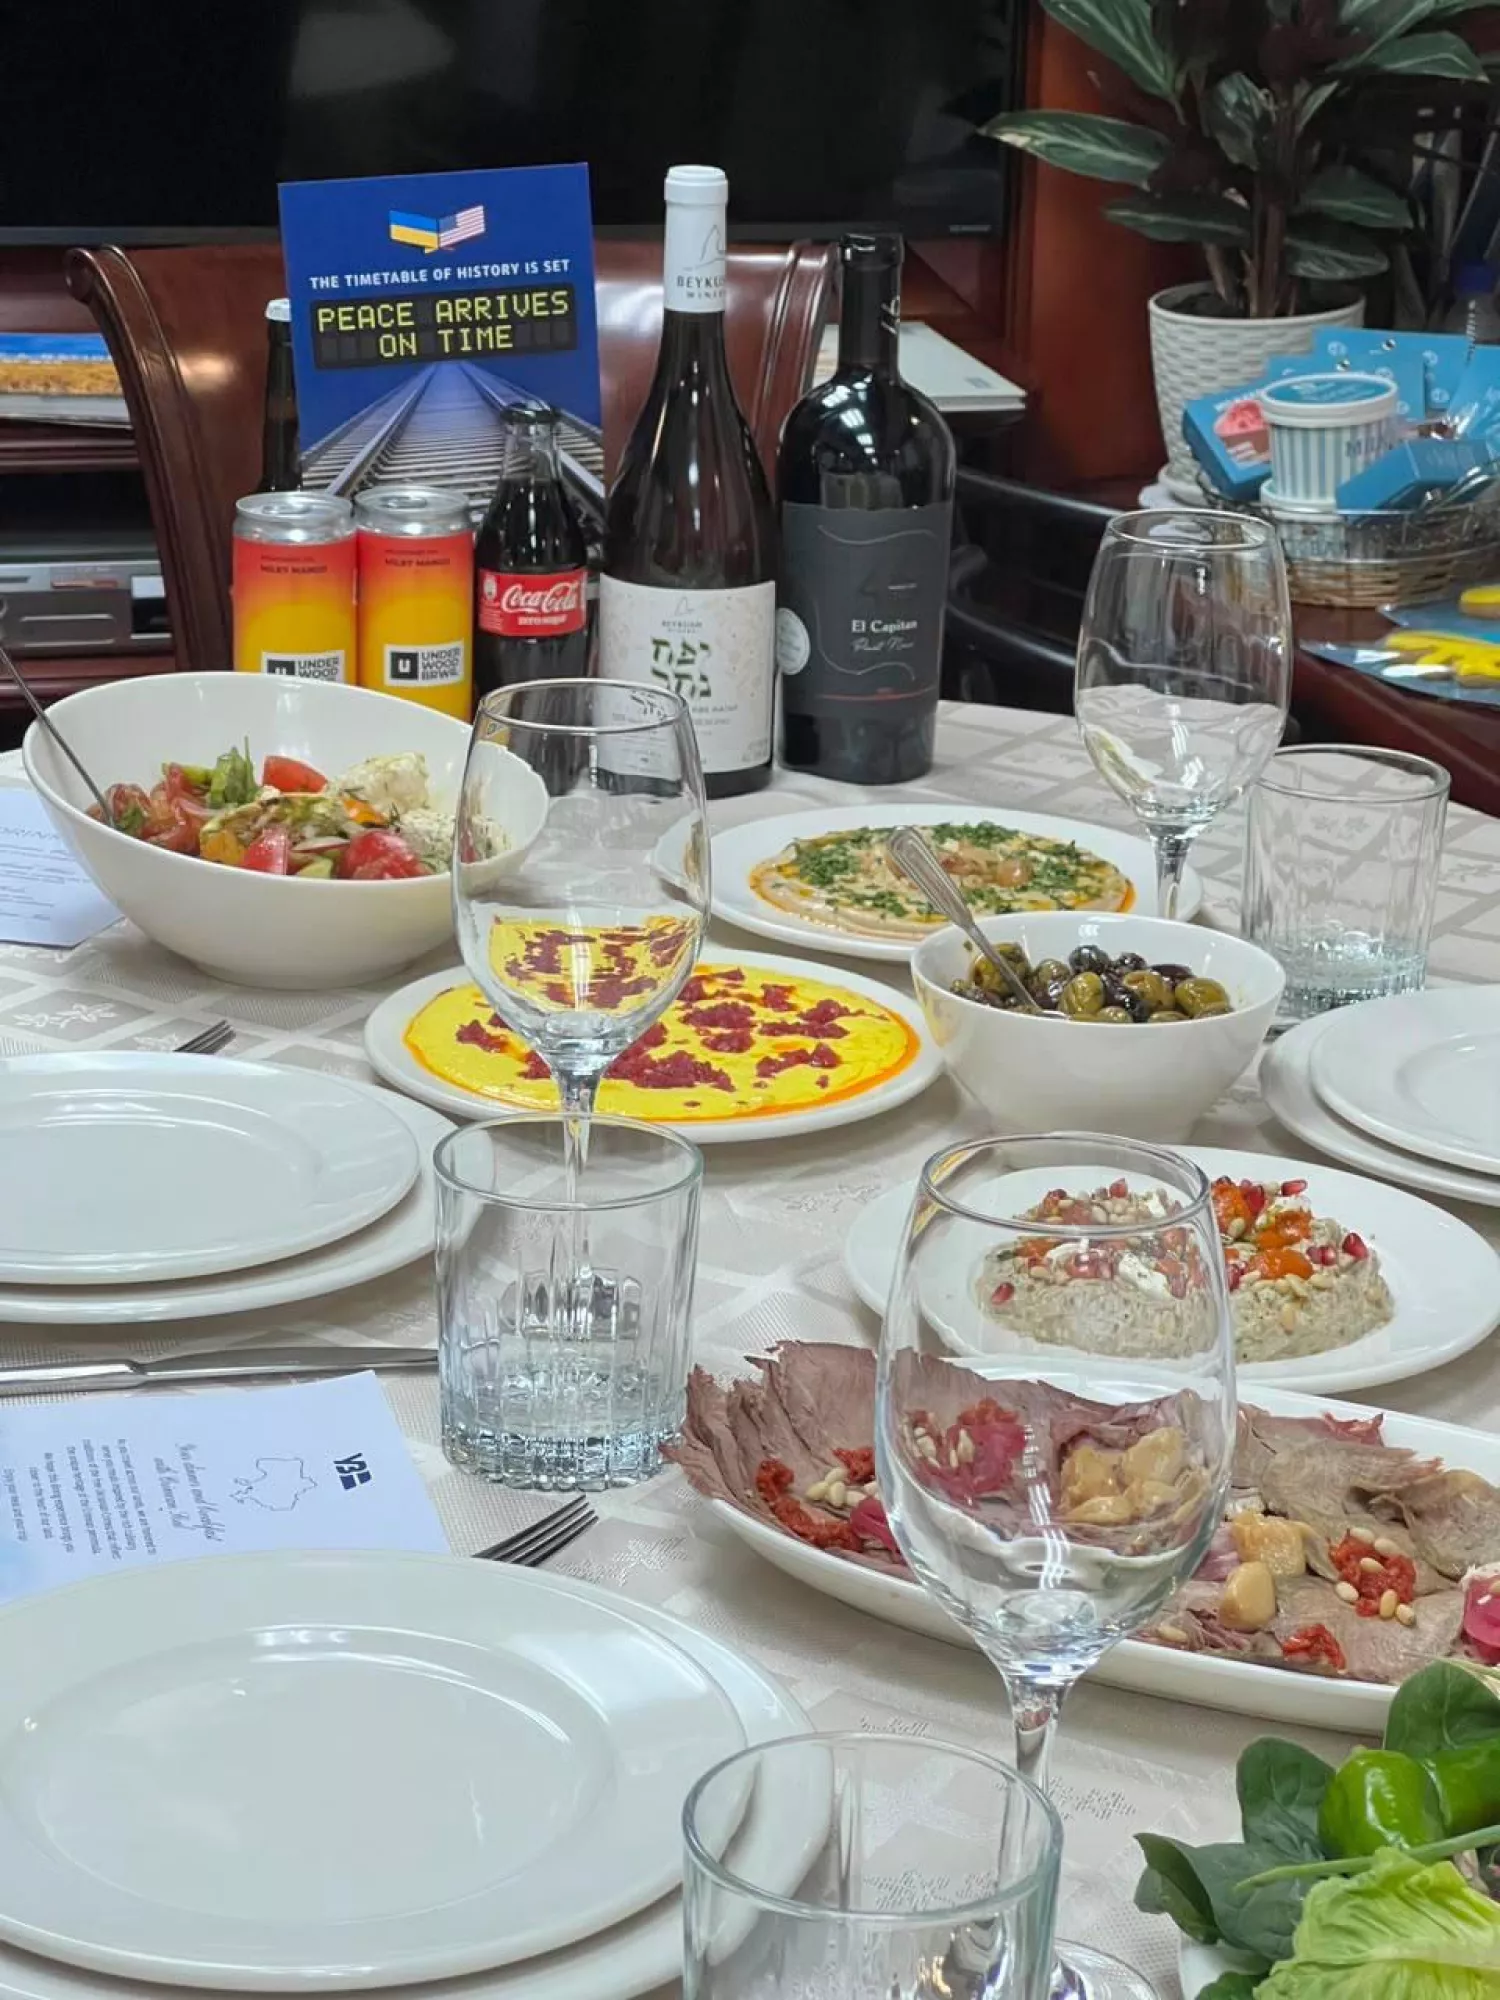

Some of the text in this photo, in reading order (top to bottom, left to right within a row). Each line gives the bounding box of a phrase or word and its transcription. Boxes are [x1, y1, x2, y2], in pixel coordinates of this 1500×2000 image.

[310, 259, 570, 289] THE TIMETABLE OF HISTORY IS SET
[317, 290, 569, 333] PEACE ARRIVES
[379, 324, 514, 358] ON TIME
[851, 618, 918, 633] El Capitan
[299, 655, 340, 669] UNDER
[299, 667, 339, 679] WOOD
